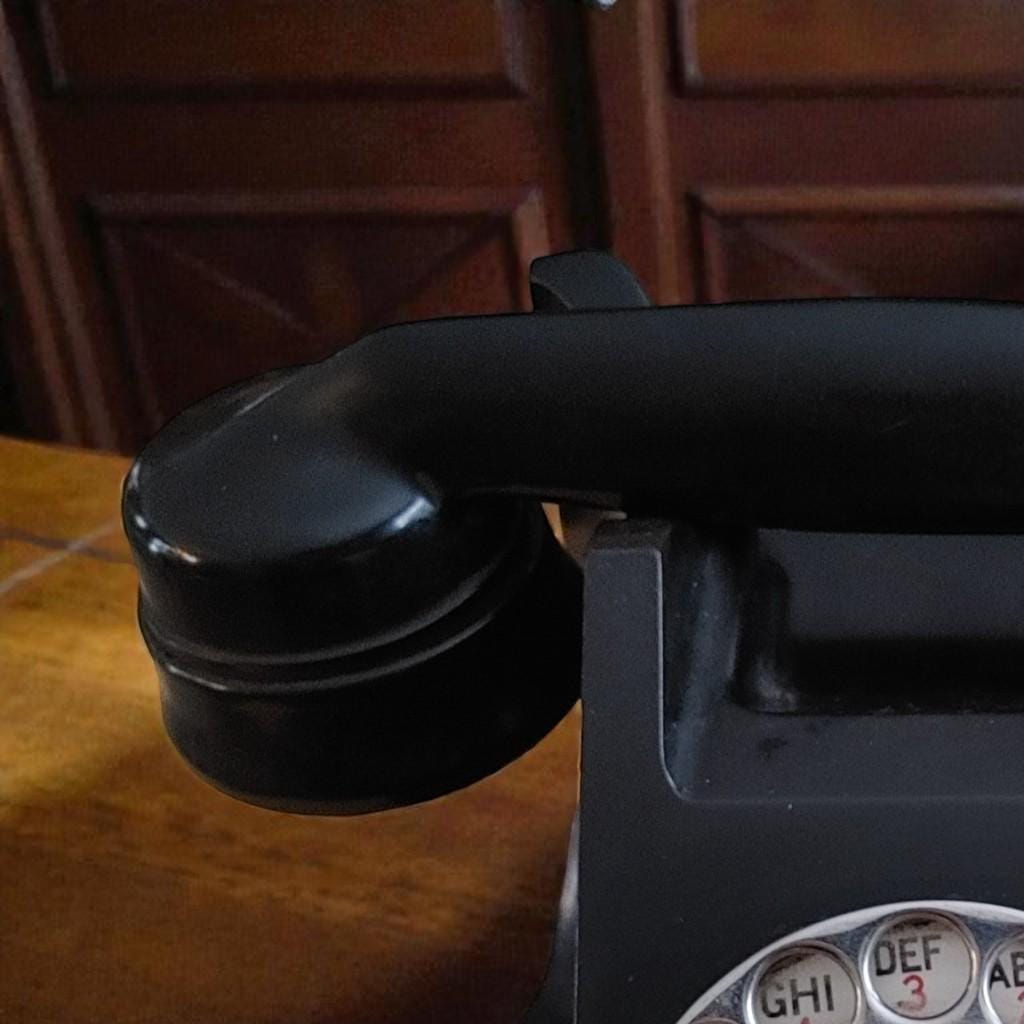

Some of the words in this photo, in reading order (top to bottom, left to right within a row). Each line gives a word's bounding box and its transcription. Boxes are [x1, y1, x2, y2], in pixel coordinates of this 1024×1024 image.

[874, 935, 942, 976] DEF
[760, 974, 835, 1018] GHI
[899, 974, 927, 1010] 3
